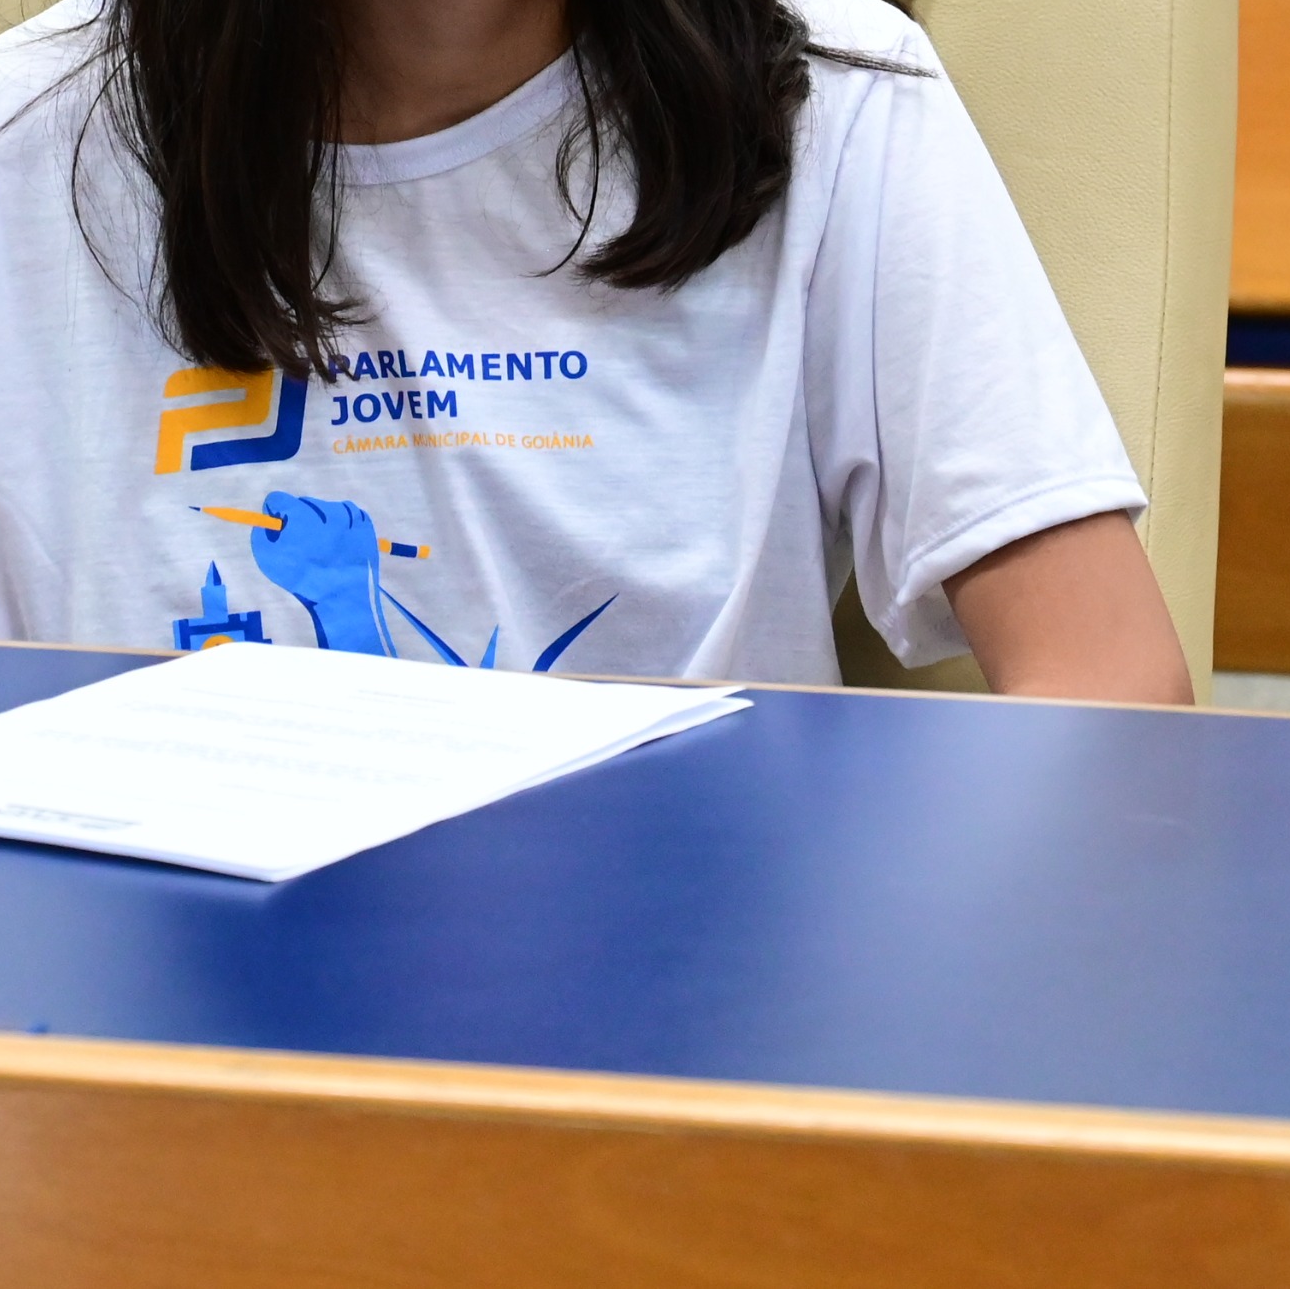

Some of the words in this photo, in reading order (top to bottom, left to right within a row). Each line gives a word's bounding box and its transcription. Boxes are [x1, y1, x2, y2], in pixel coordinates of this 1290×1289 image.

[328, 350, 588, 381] PARLAMENTO
[331, 390, 458, 426] JOVEM
[333, 434, 408, 455] CÂMARA
[495, 433, 516, 448] DE
[521, 431, 594, 450] GOIÂNIA
